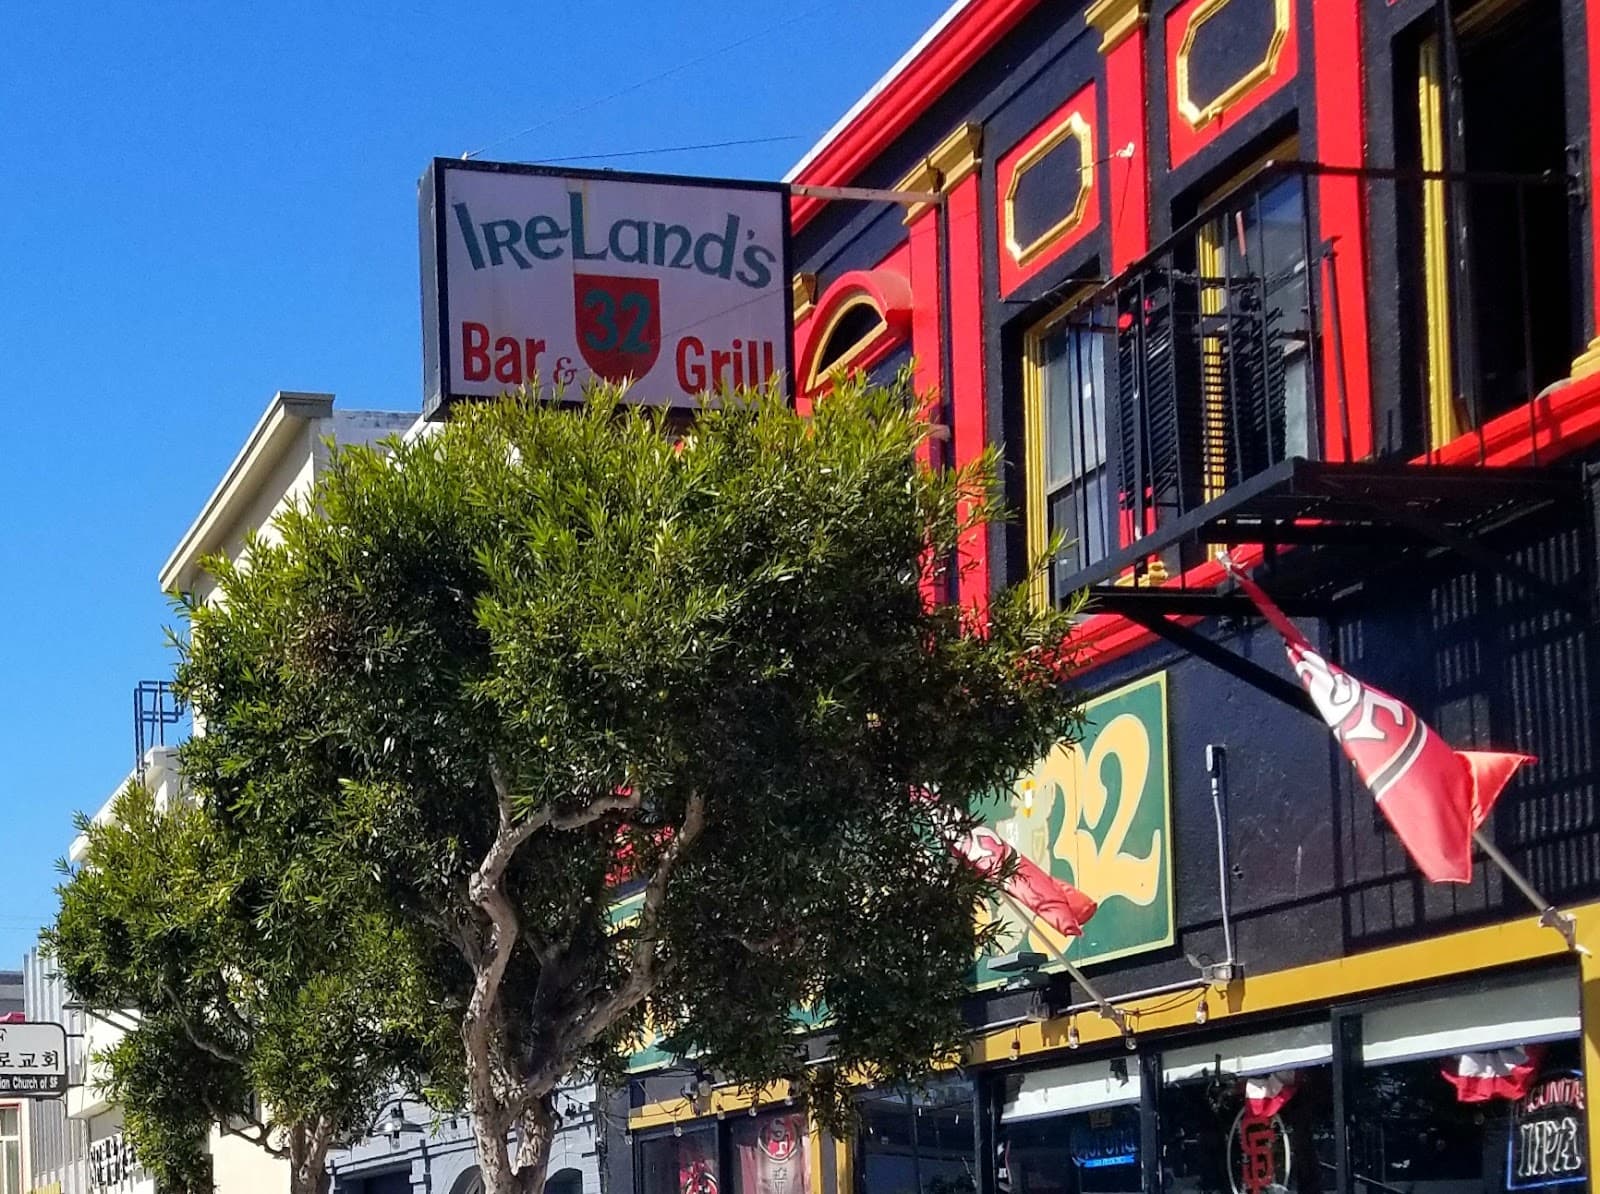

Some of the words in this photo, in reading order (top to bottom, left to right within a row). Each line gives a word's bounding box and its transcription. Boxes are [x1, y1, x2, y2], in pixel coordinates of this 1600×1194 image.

[584, 288, 652, 354] 32
[461, 321, 546, 385] Bar
[553, 356, 577, 386] &
[675, 335, 774, 395] Grill
[12, 1076, 38, 1090] Church
[40, 1076, 48, 1089] of
